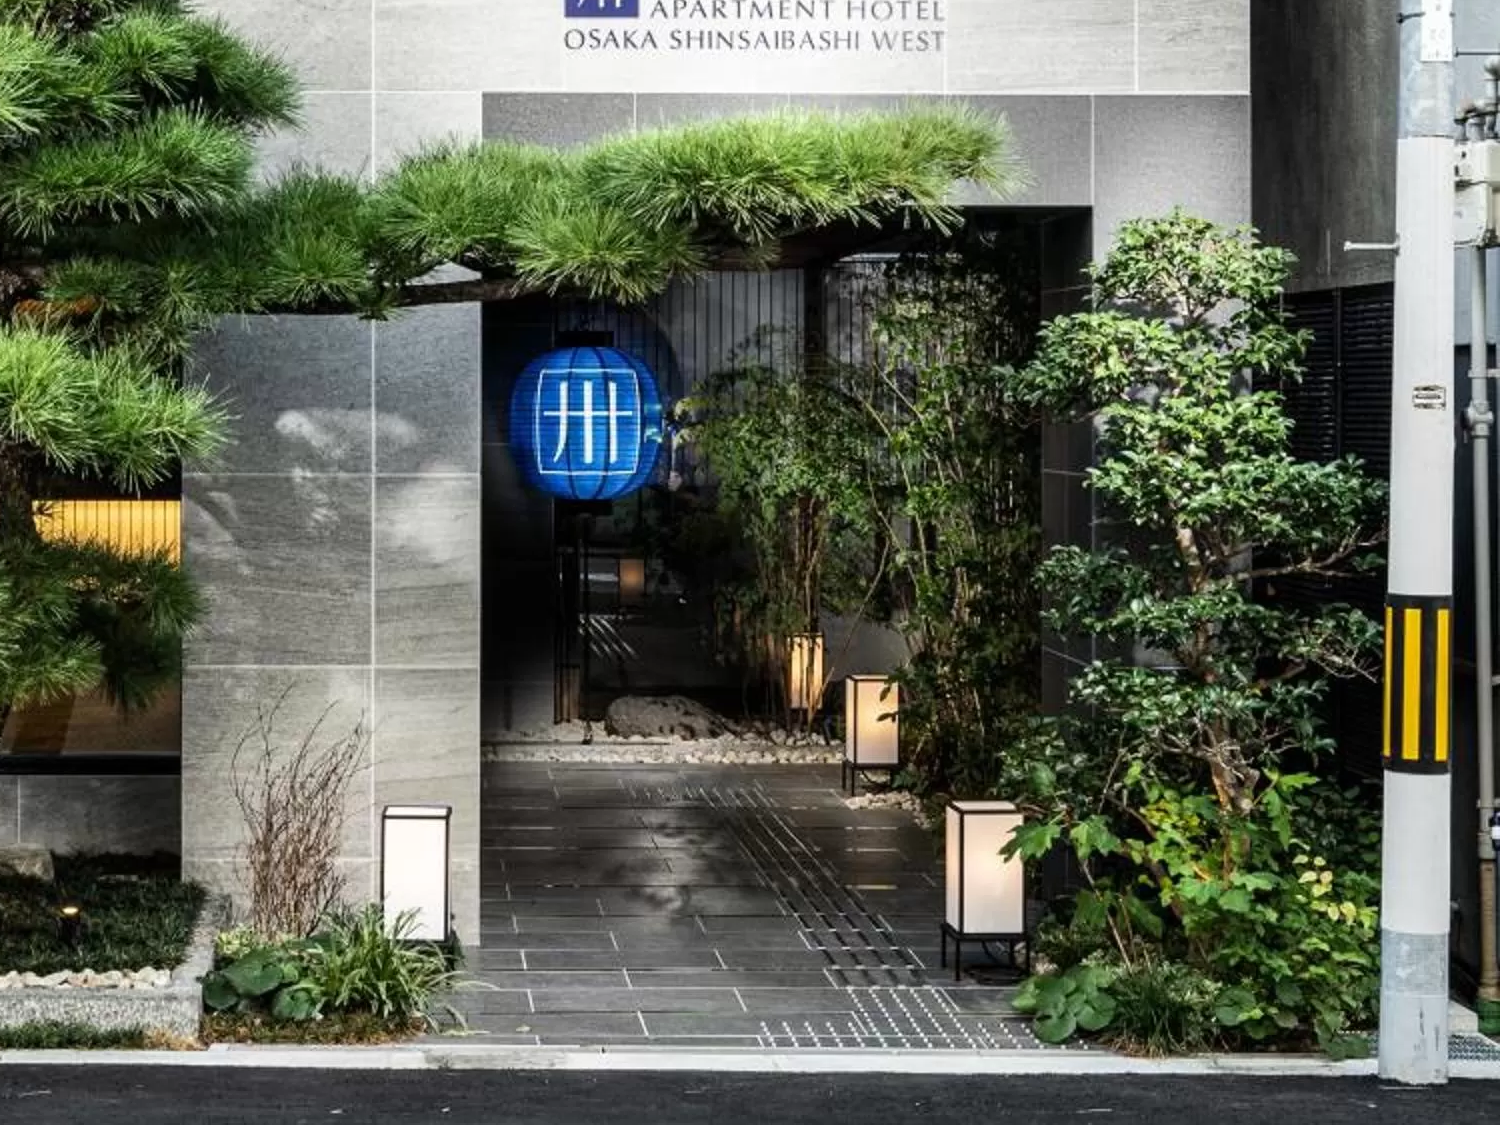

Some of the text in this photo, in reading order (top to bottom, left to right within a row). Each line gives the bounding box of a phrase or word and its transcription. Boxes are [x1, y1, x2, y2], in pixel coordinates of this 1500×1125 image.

[847, 0, 946, 21] HOTEL
[563, 28, 946, 52] OSAKA SHINSAIBASHI WEST
